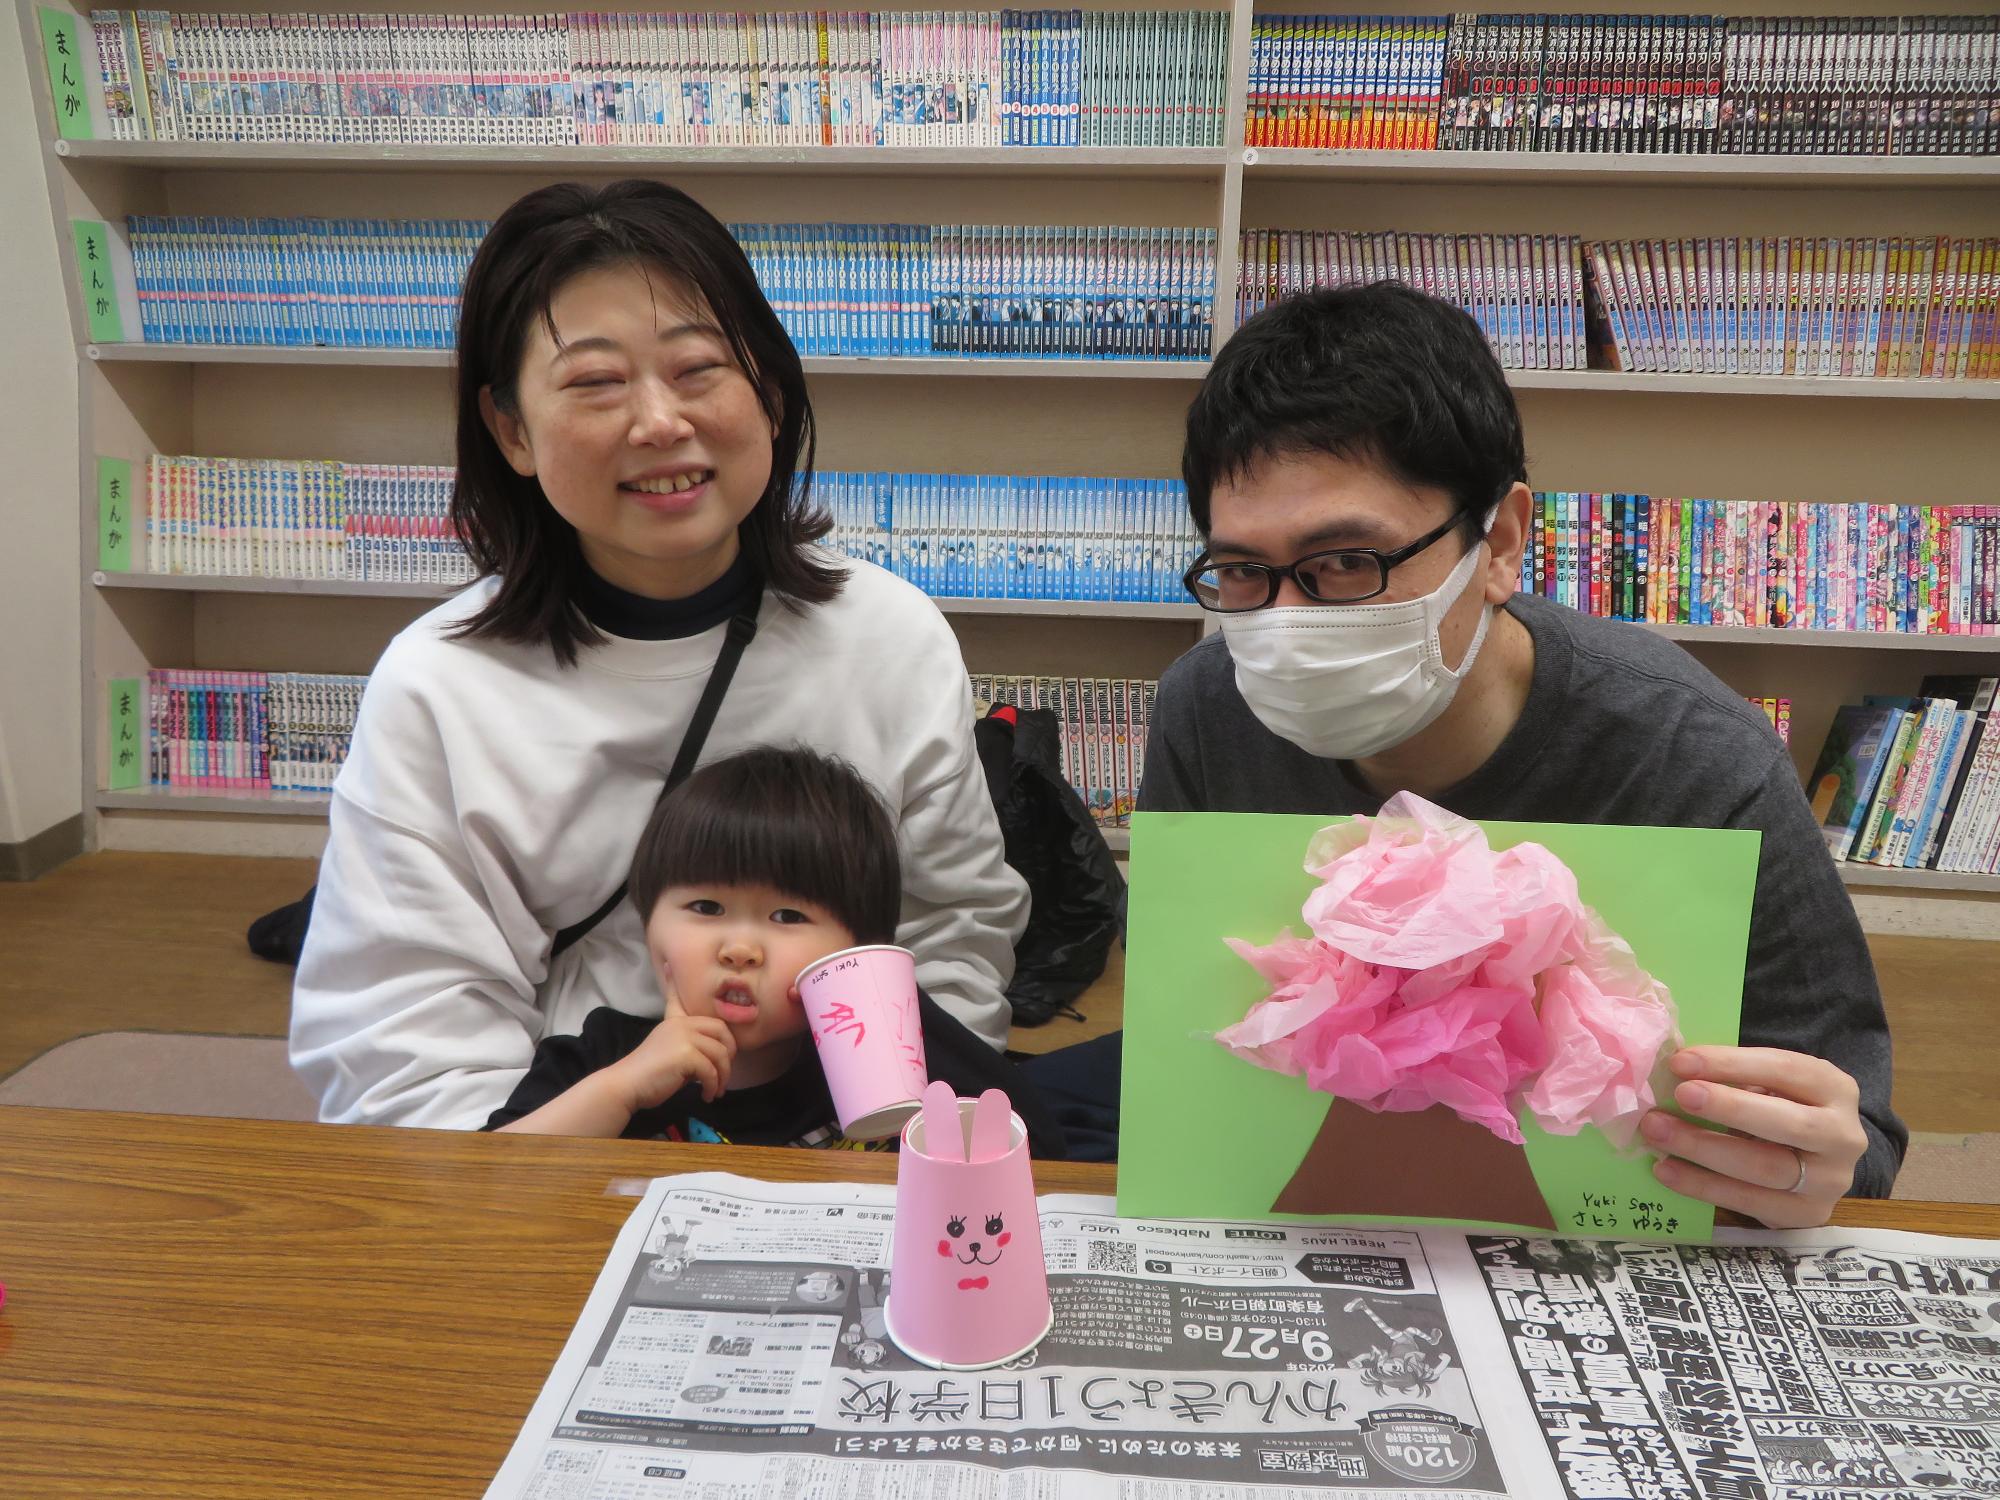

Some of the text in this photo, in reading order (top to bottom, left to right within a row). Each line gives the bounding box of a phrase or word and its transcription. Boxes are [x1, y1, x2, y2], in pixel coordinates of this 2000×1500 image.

[56, 30, 80, 117] まんが
[1269, 41, 1282, 95] はじめの一歩
[1322, 41, 1334, 95] はじめの一歩
[1343, 42, 1356, 96] はじめの一歩
[1376, 42, 1390, 96] はじめの一歩
[1420, 42, 1432, 96] はじめの一歩
[1822, 100, 1827, 108] 9
[1831, 100, 1840, 109] 10
[761, 242, 770, 288] MAJOR
[804, 242, 813, 288] MAJOR
[837, 242, 847, 288] MAJOR
[921, 242, 930, 290] MAJOR
[87, 236, 109, 316] まんが
[109, 478, 122, 548] まんが
[347, 540, 352, 550] 1
[355, 540, 360, 550] 2
[365, 541, 371, 550] 3
[383, 541, 389, 551] 5
[402, 542, 407, 552] 7
[421, 542, 428, 552] 9
[120, 692, 133, 767] まんが
[1583, 1192, 1616, 1208] Yuki
[1080, 1225, 1120, 1234] UACJ
[1572, 1211, 1679, 1234] さとう ゆうき
[1137, 1225, 1210, 1238] Nabtesco
[1229, 1230, 1281, 1239] LOTTE
[1301, 1237, 1385, 1248] HEBEL HAUS
[1311, 1256, 1399, 1268] 朝日イーポストから
[1188, 1265, 1279, 1278] 朝日イーポスト
[1313, 1264, 1401, 1278] 二次元コードまたは
[1344, 1274, 1404, 1287] お申し込みは
[1799, 1290, 1898, 1302] 歩行の新常識
[1181, 1296, 1324, 1314] 有楽町朝日ホール
[1804, 1300, 1906, 1315] 1日7000歩!
[1286, 1363, 1335, 1371] 2025年
[1712, 1326, 1780, 1414] 中居正広
[838, 1377, 1346, 1424] かんきょう1日学校
[1756, 1420, 1866, 1437] 最速ガイド
[1870, 1423, 1992, 1450] 血圧手帳
[1385, 1433, 1451, 1444] 無料ご招待
[1386, 1445, 1459, 1468] 120組
[1823, 1439, 1880, 1462] 沖縄
[1259, 1449, 1366, 1478] 地球教室
[1771, 1460, 1897, 1484] ジャングリア
